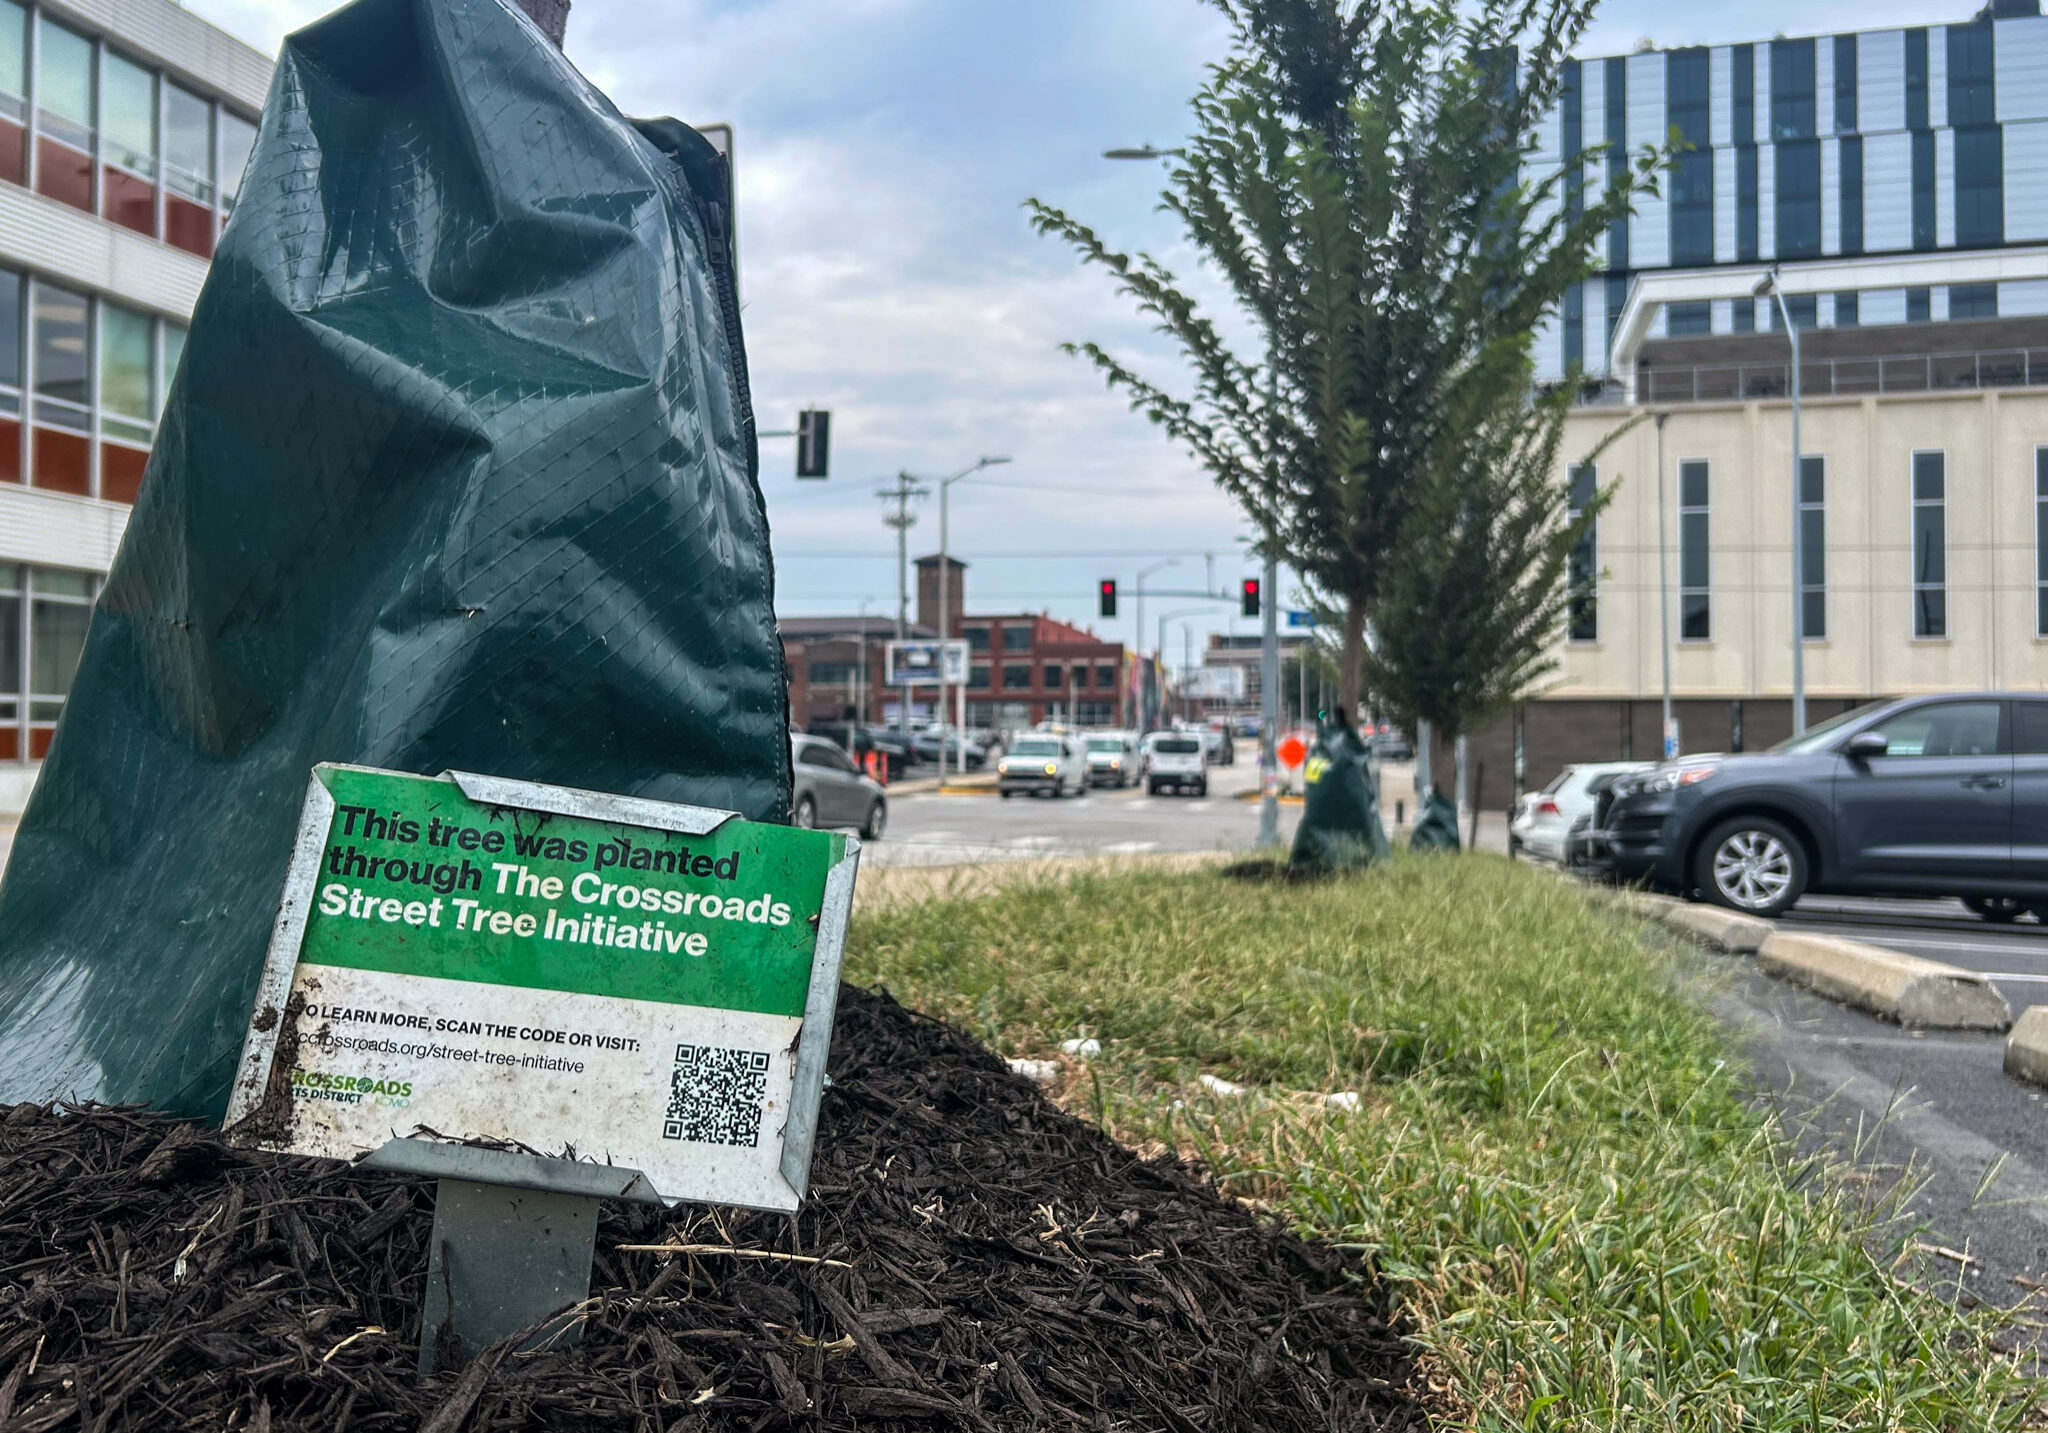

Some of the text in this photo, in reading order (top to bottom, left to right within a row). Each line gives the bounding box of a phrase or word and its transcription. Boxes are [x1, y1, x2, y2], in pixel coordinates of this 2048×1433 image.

[339, 804, 740, 881] This tree was planted
[329, 845, 791, 926] through The Crossroads
[318, 883, 708, 957] Street Tree Initiative
[321, 1005, 377, 1024] LEARN
[380, 1012, 432, 1032] MORE,
[435, 1018, 482, 1035] SCAN
[485, 1023, 517, 1039] THE
[519, 1027, 567, 1044] CODE
[568, 1032, 593, 1047] OR
[595, 1035, 641, 1052] VISIT:
[297, 1032, 585, 1074] ccrossroads.org/street-tree-initiative
[292, 1069, 413, 1097] ROSSROADS
[310, 1089, 363, 1104] DISTRICT
